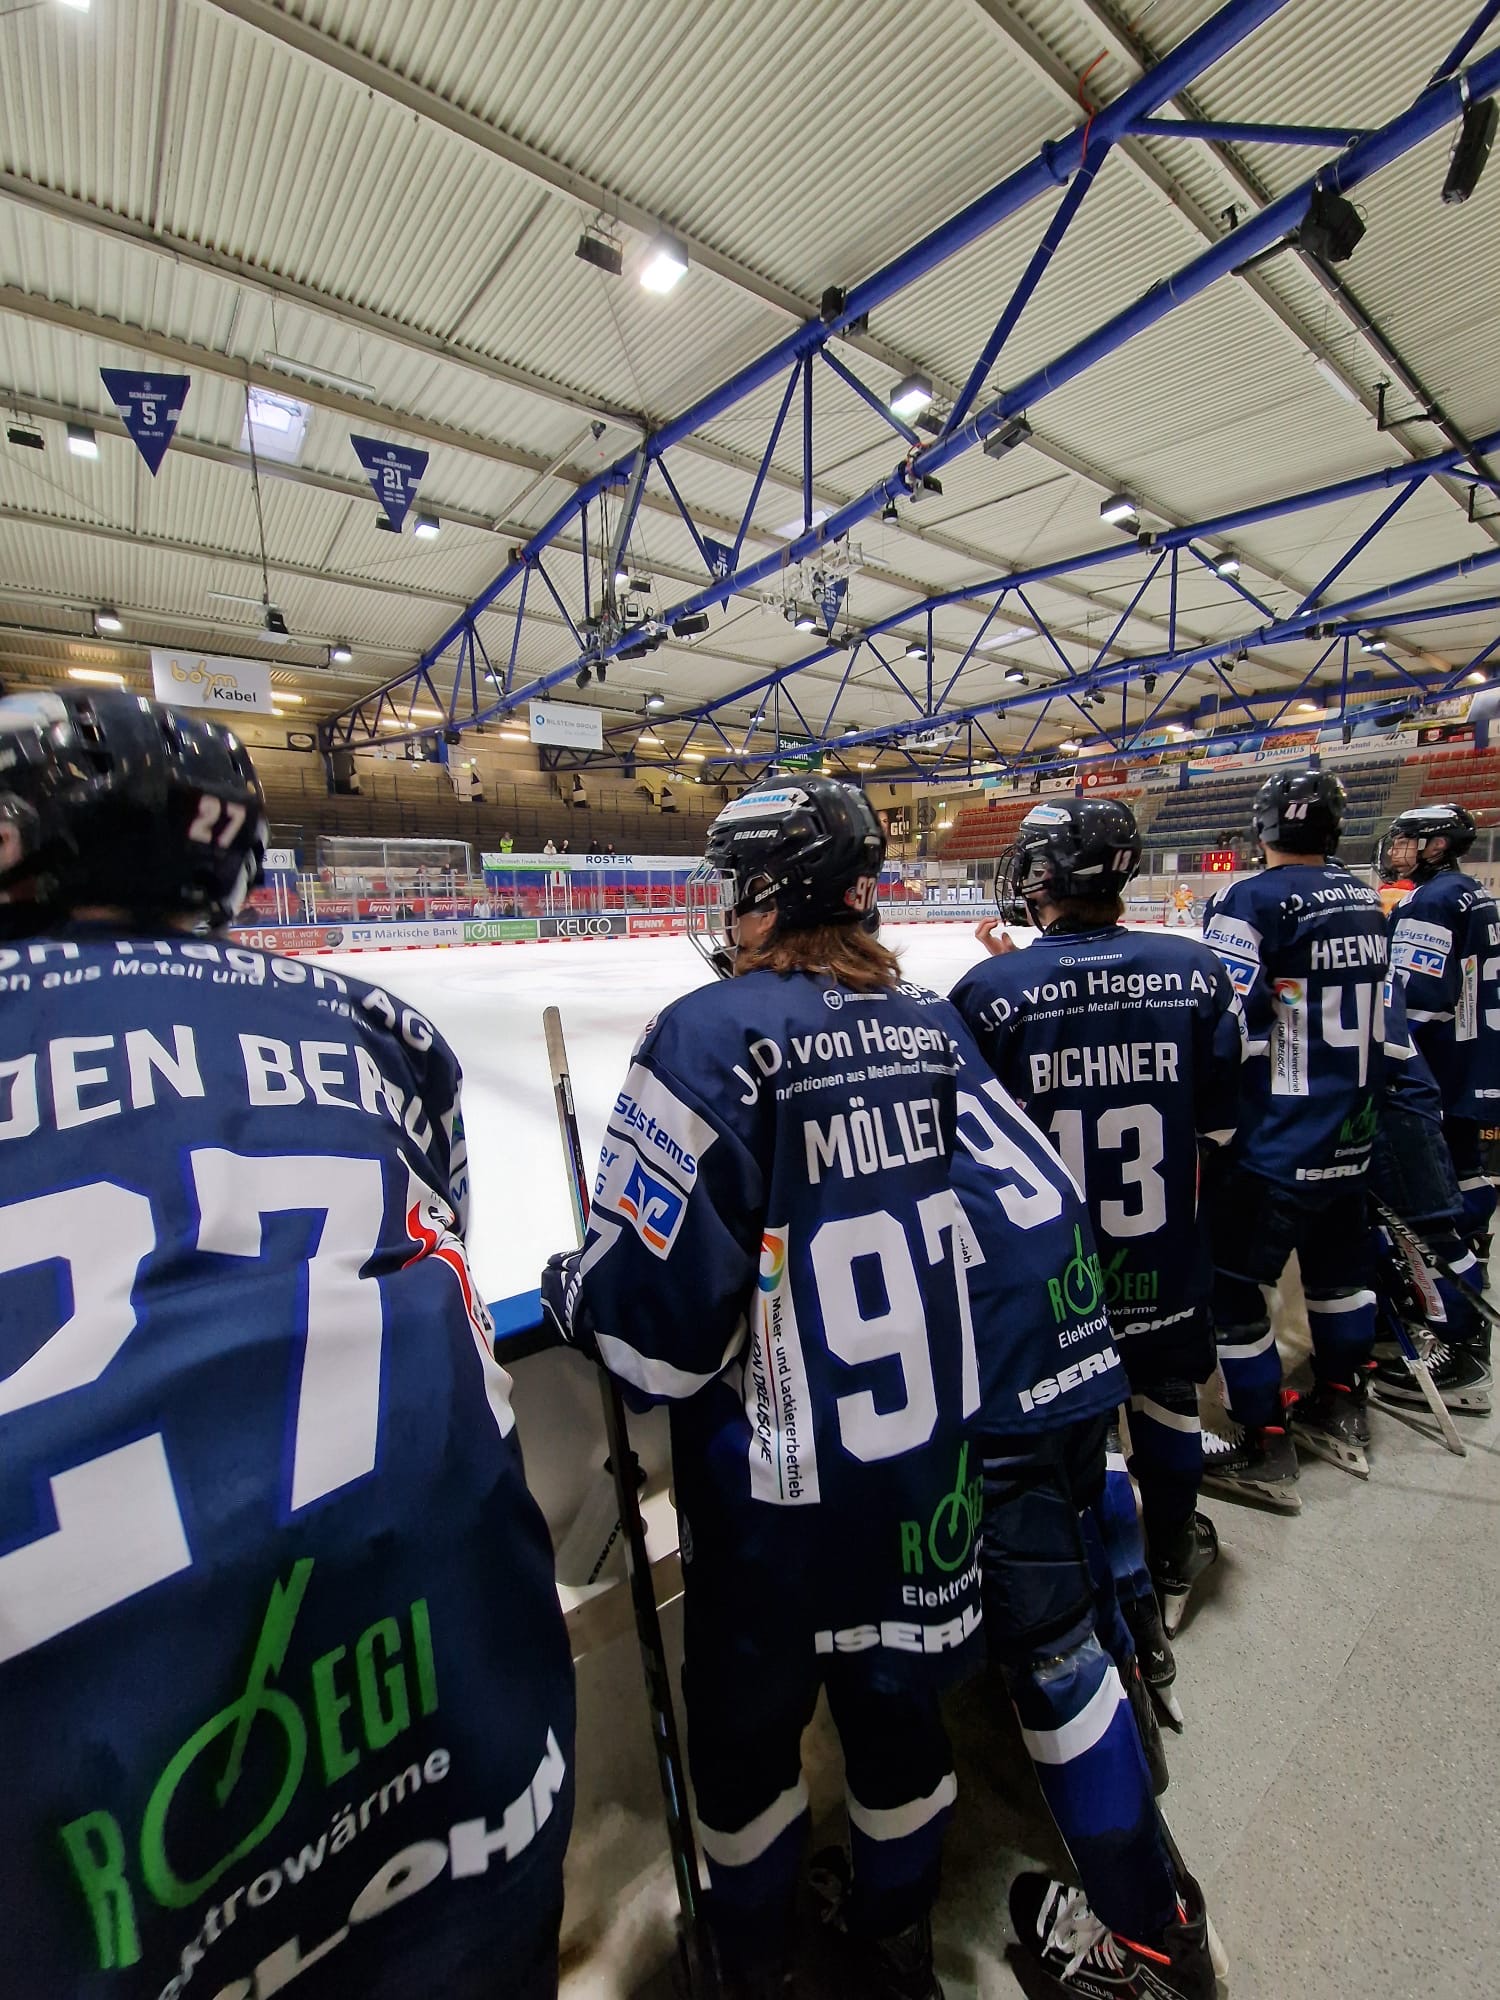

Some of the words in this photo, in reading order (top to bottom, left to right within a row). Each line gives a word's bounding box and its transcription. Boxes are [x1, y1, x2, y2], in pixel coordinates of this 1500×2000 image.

[142, 401, 158, 426] 5
[383, 467, 404, 491] 21
[213, 687, 257, 703] Kabel
[189, 794, 247, 849] 27
[733, 829, 779, 841] BAUER
[890, 821, 910, 837] GO!
[585, 855, 633, 865] ROSTEK
[854, 875, 878, 912] 97
[1312, 885, 1347, 904] von
[882, 907, 921, 916] MEDICE
[240, 930, 278, 949] tde
[374, 928, 430, 939] Märkische
[432, 927, 458, 937] Bank
[556, 918, 612, 936] KEUCO
[42, 965, 101, 989] aus
[112, 959, 203, 980] Metall
[1022, 979, 1078, 1005] von
[1087, 969, 1183, 999] Hagen
[1066, 1004, 1085, 1016] aus
[1087, 1000, 1120, 1013] Metall
[1121, 999, 1142, 1011] und
[790, 1029, 854, 1066] von
[856, 1017, 946, 1061] Hagen
[1029, 1042, 1179, 1095] BICHNER
[613, 1092, 698, 1176] Systems
[599, 1145, 620, 1168] er
[1048, 1103, 1168, 1238] 13
[771, 1295, 782, 1343] Maler-
[809, 1189, 982, 1464] 97
[775, 1346, 792, 1376] und
[1017, 1346, 1121, 1415] ISERL
[0, 1147, 385, 1665] 27
[751, 1372, 773, 1465] DREUSCHE
[779, 1376, 804, 1500] Lackiererbetrieb
[814, 1603, 984, 1655] ISERL
